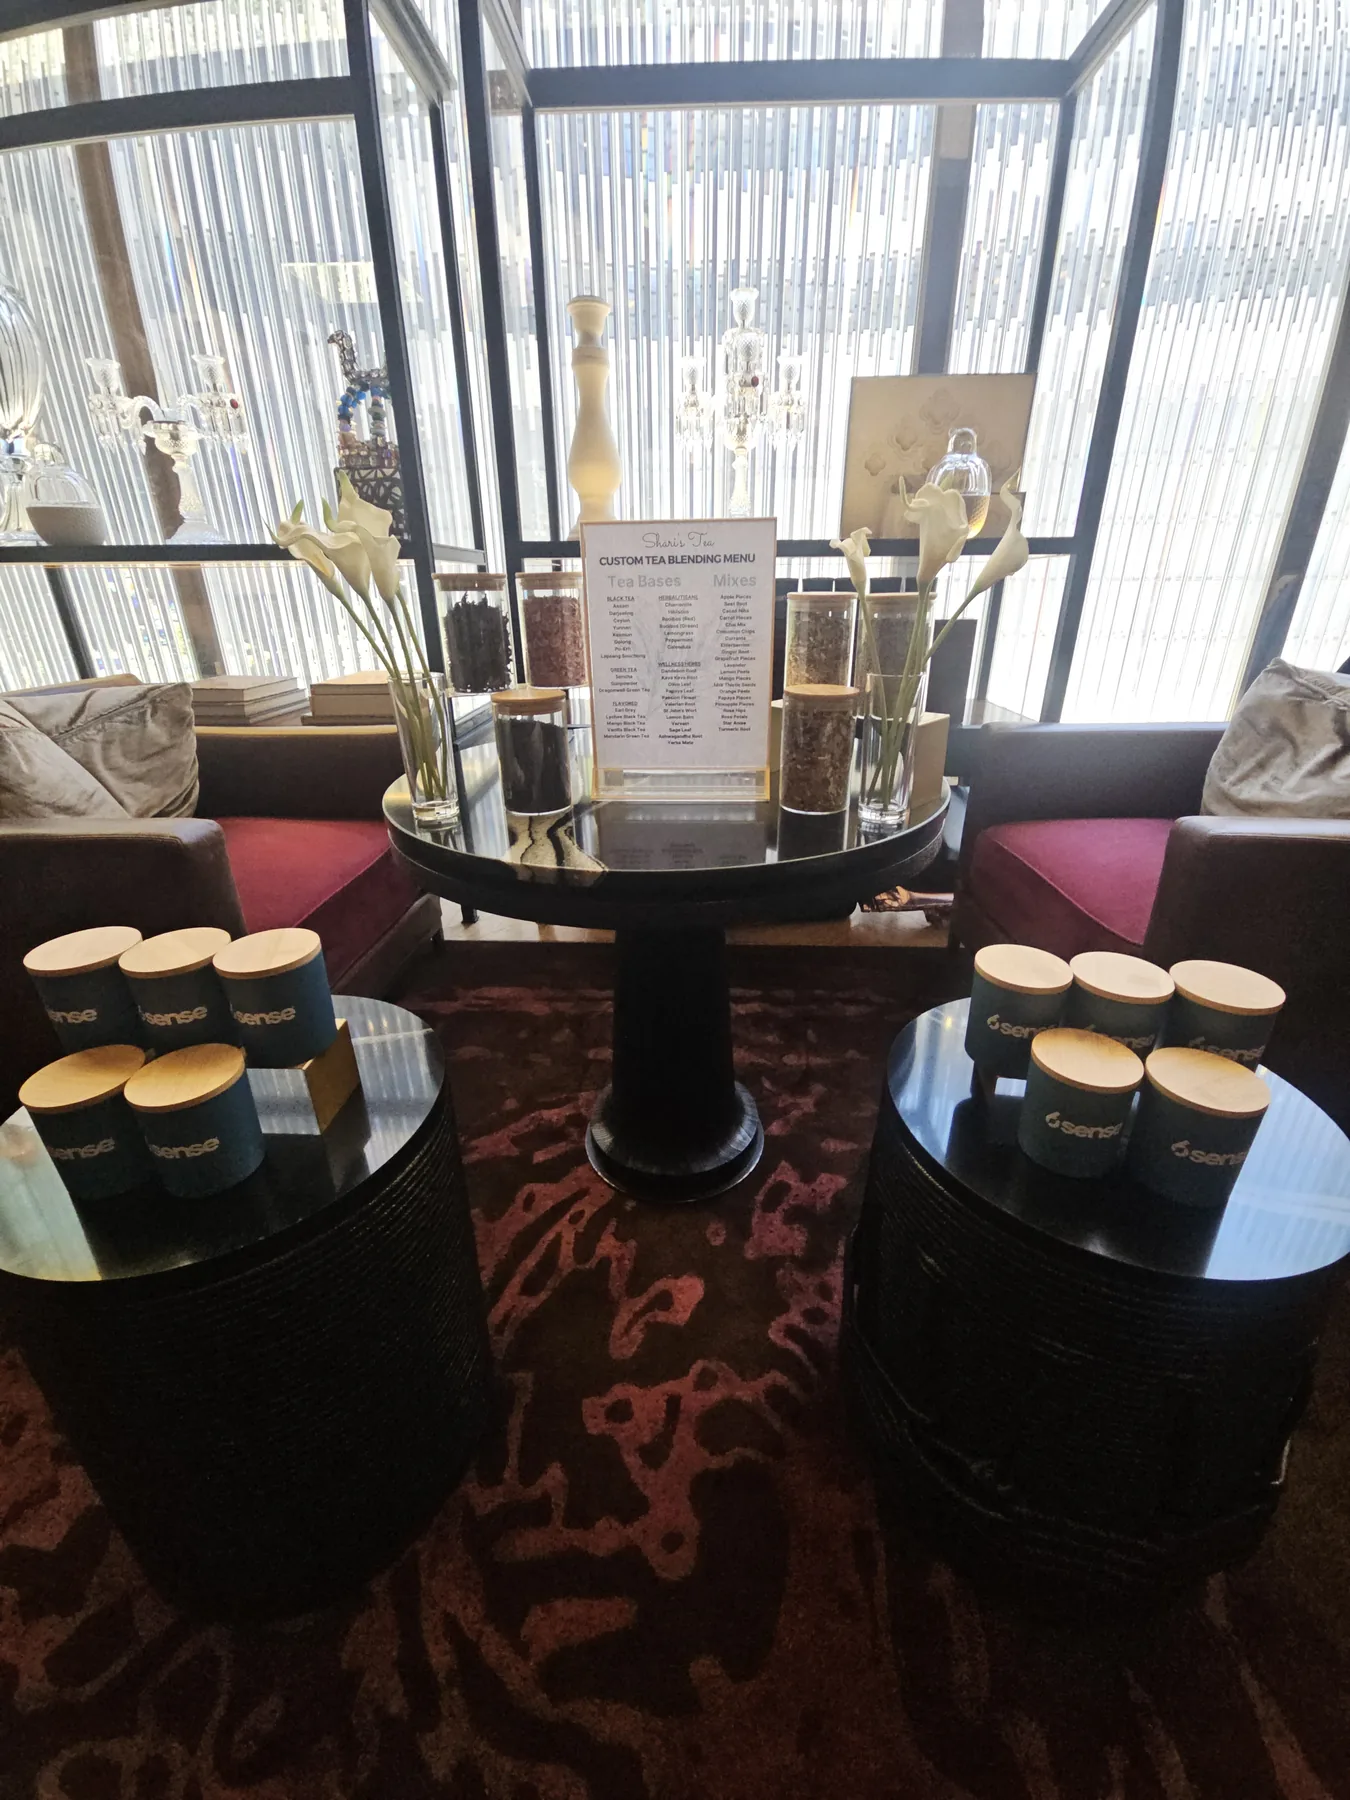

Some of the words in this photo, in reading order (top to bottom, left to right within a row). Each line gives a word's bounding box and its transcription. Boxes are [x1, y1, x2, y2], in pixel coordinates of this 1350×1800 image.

[688, 531, 715, 547] Tea
[600, 556, 643, 565] CUSTOM
[645, 556, 666, 564] TEA
[668, 554, 721, 564] BLENDING
[723, 553, 755, 563] MENU
[608, 576, 634, 588] Tea
[638, 575, 681, 587] Bases
[714, 574, 756, 587] Mixes
[138, 1005, 208, 1026] sense
[229, 1001, 296, 1025] sense
[145, 1136, 219, 1159] sense
